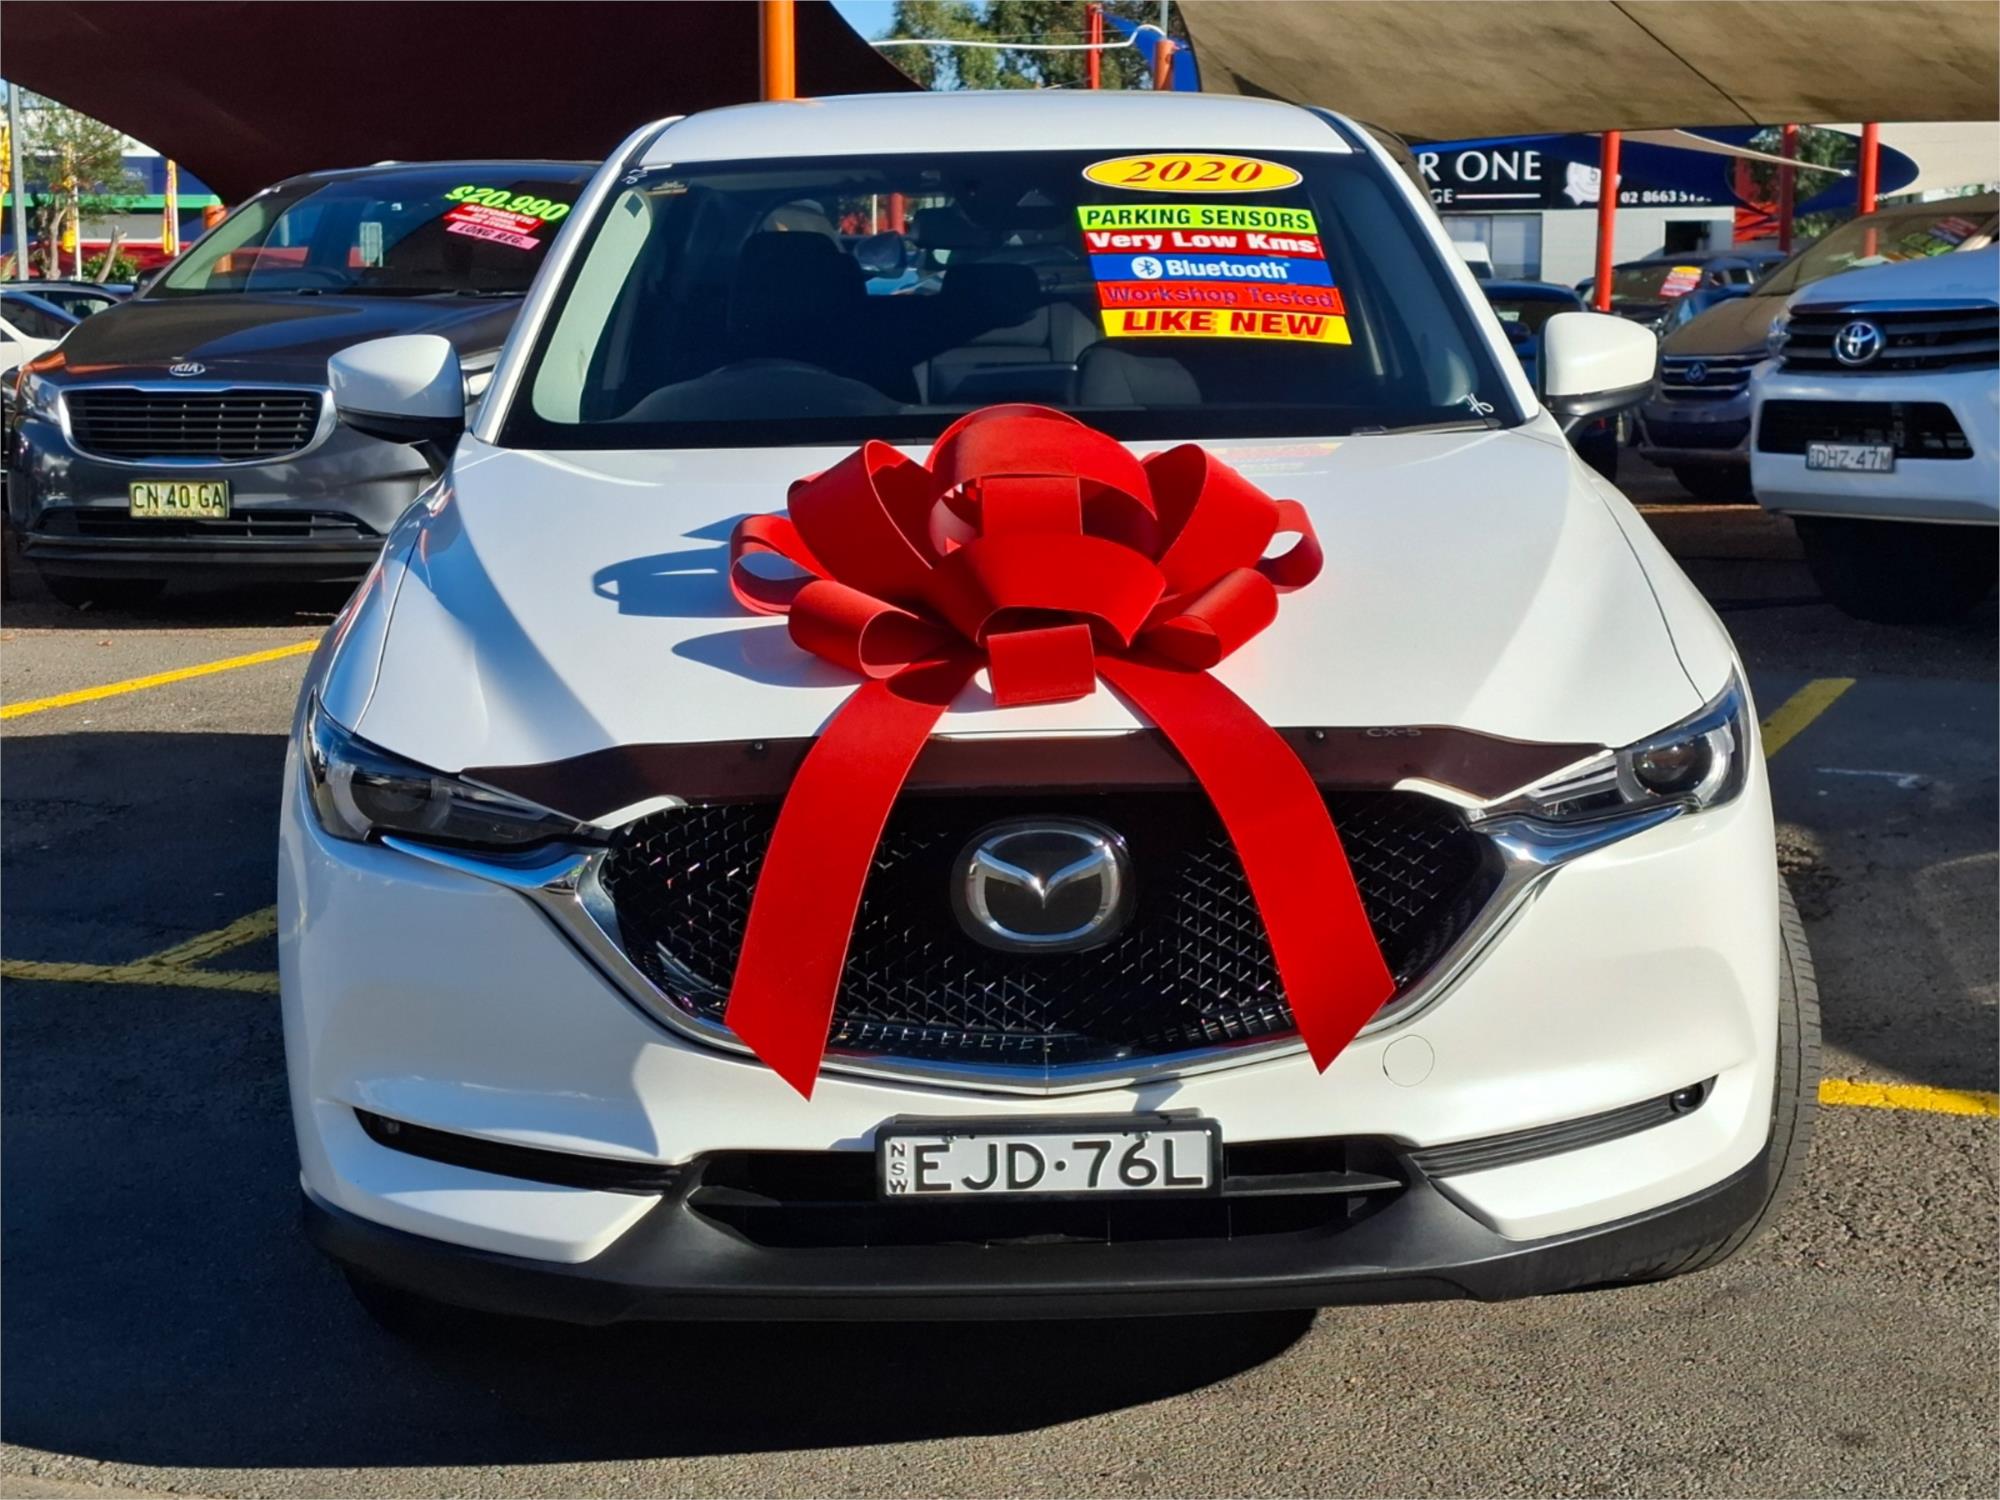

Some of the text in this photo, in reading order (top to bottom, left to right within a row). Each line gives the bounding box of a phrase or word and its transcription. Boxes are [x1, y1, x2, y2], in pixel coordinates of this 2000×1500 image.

[1120, 160, 1264, 184] 2020
[1455, 150, 1542, 182] ONE
[1620, 190, 1638, 204] 02
[1642, 189, 1677, 204] 8663
[458, 224, 495, 237] LONG
[1086, 209, 1310, 230] PARKING SENSORS
[1087, 231, 1319, 253] Very Low Kms
[1165, 259, 1288, 280] Bluetooth
[1106, 286, 1335, 309] Workshop Tested
[1122, 310, 1326, 337] LIKE NEW
[1366, 727, 1422, 737] CX-5
[889, 1143, 908, 1193] NSW
